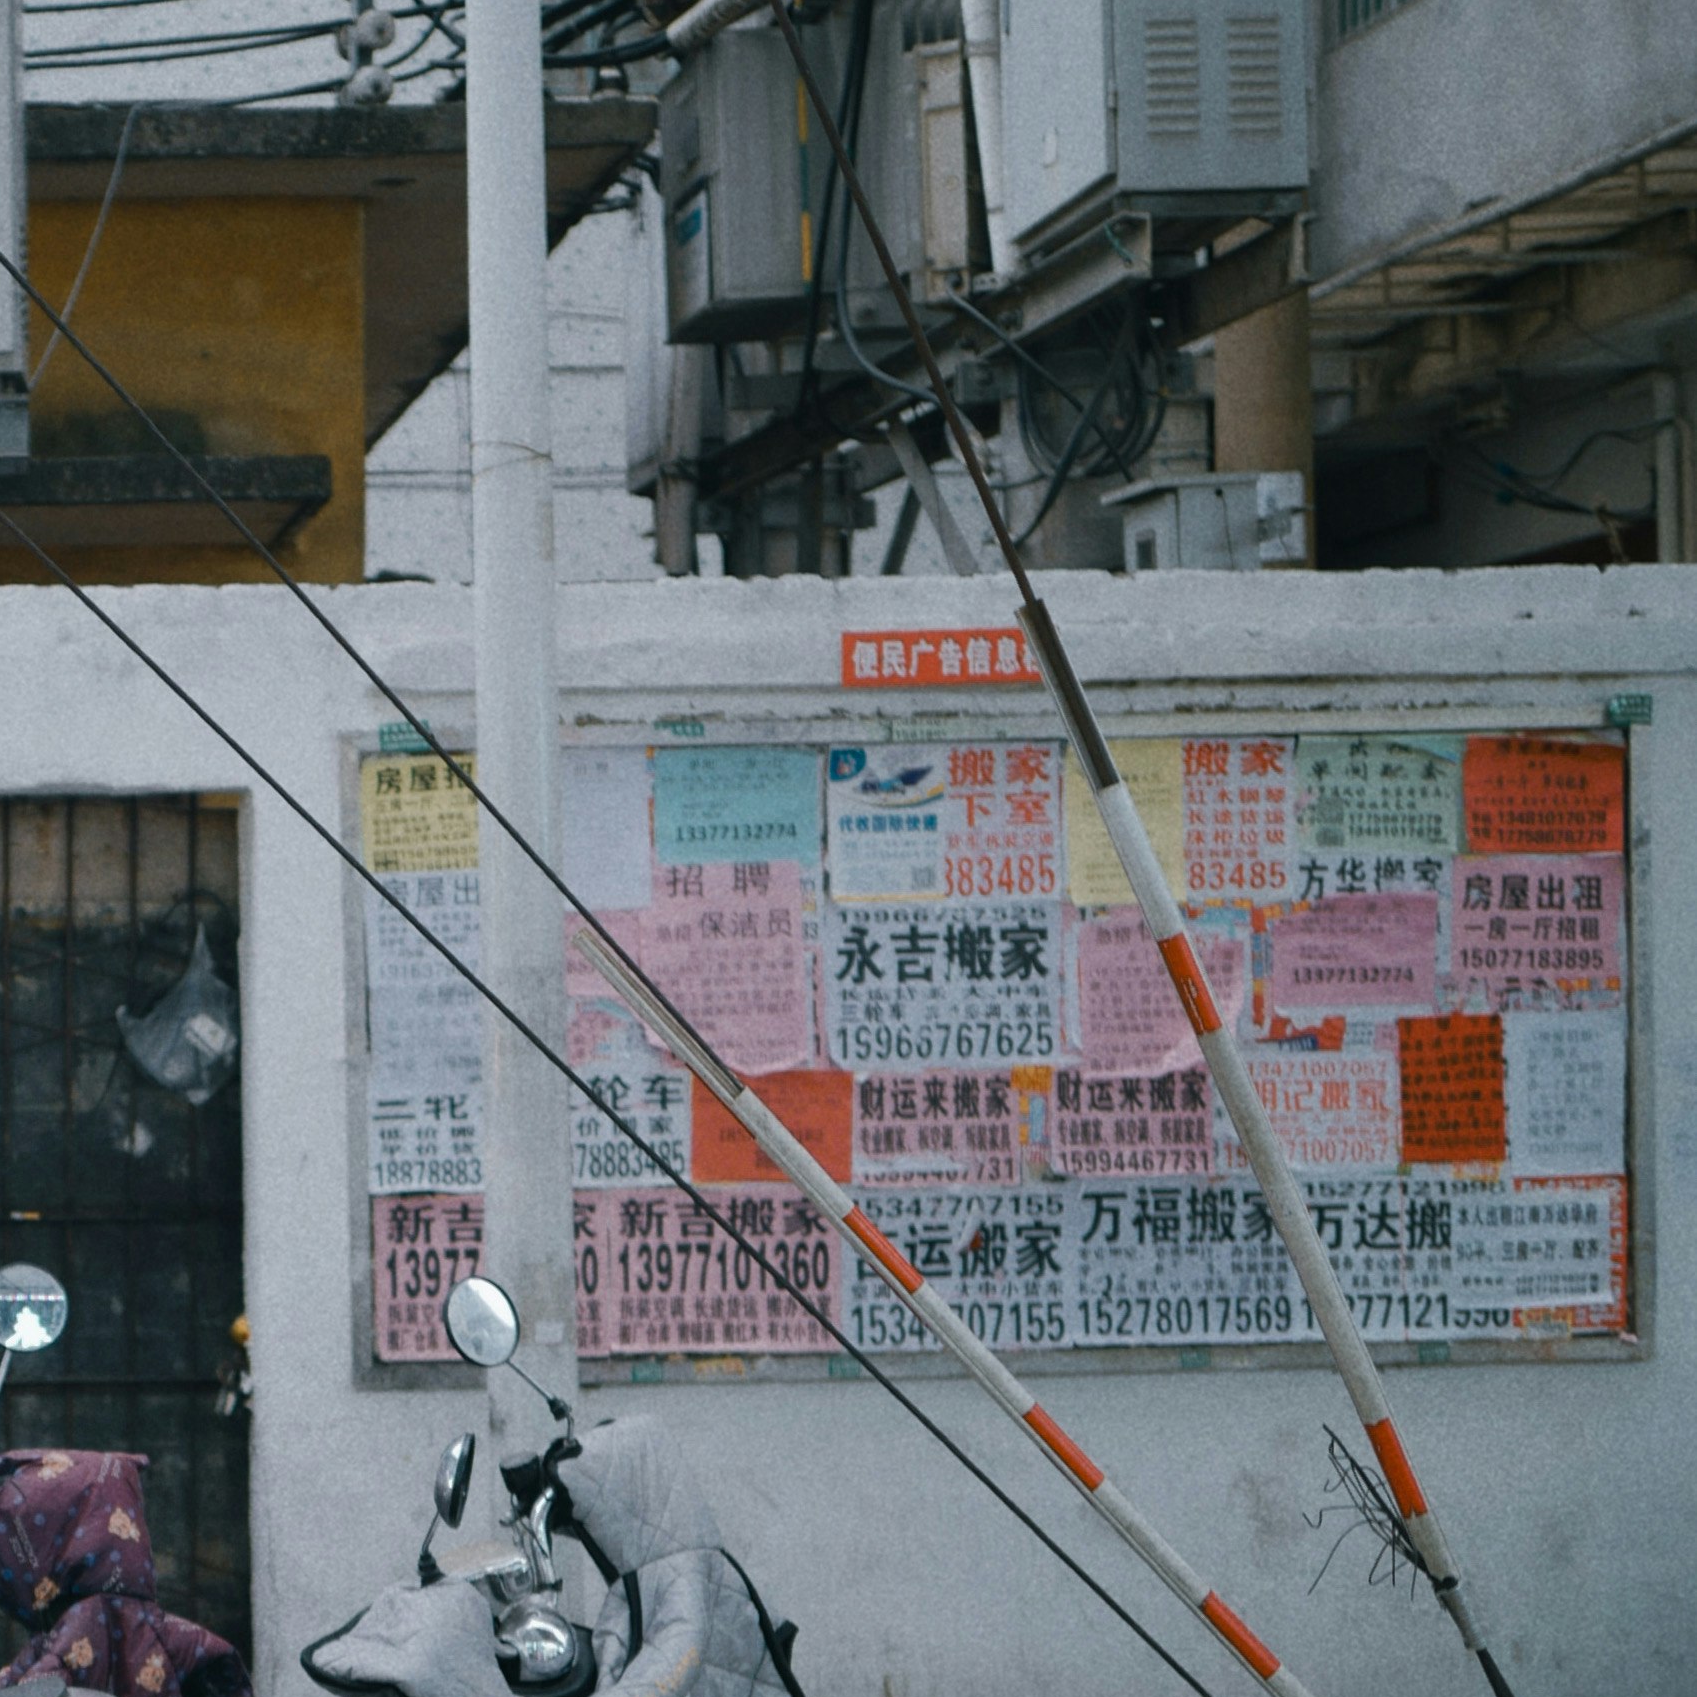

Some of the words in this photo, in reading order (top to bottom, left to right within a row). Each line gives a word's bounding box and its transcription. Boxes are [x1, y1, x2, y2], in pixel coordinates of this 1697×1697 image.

[949, 747, 1052, 787] 搬家
[1185, 741, 1286, 777] 搬家
[949, 791, 1052, 829] 下室
[664, 862, 770, 898] 招聘
[1189, 862, 1287, 891] 83485
[1462, 872, 1604, 912] 房屋出租
[699, 907, 792, 940] 保洁员
[1464, 916, 1600, 942] 一房一厅招租
[834, 918, 1050, 985] 永吉搬家
[1459, 947, 1604, 971] 15077183895
[569, 1073, 685, 1112] 轮车
[859, 1073, 1013, 1122] 财运来搬家
[373, 1158, 483, 1187] 18878883
[1057, 1149, 1210, 1175] 15994467731
[386, 1201, 485, 1244] 新吉
[620, 1196, 829, 1239] 新吉搬家
[1080, 1186, 1275, 1246] 万福搬家
[1307, 1198, 1452, 1252] 万达搬
[573, 1242, 601, 1297] 0
[618, 1240, 832, 1293] 13977101360
[850, 1301, 1067, 1347] 153407155
[1077, 1294, 1293, 1337] 15278017569
[1300, 1292, 1511, 1331] 177121990
